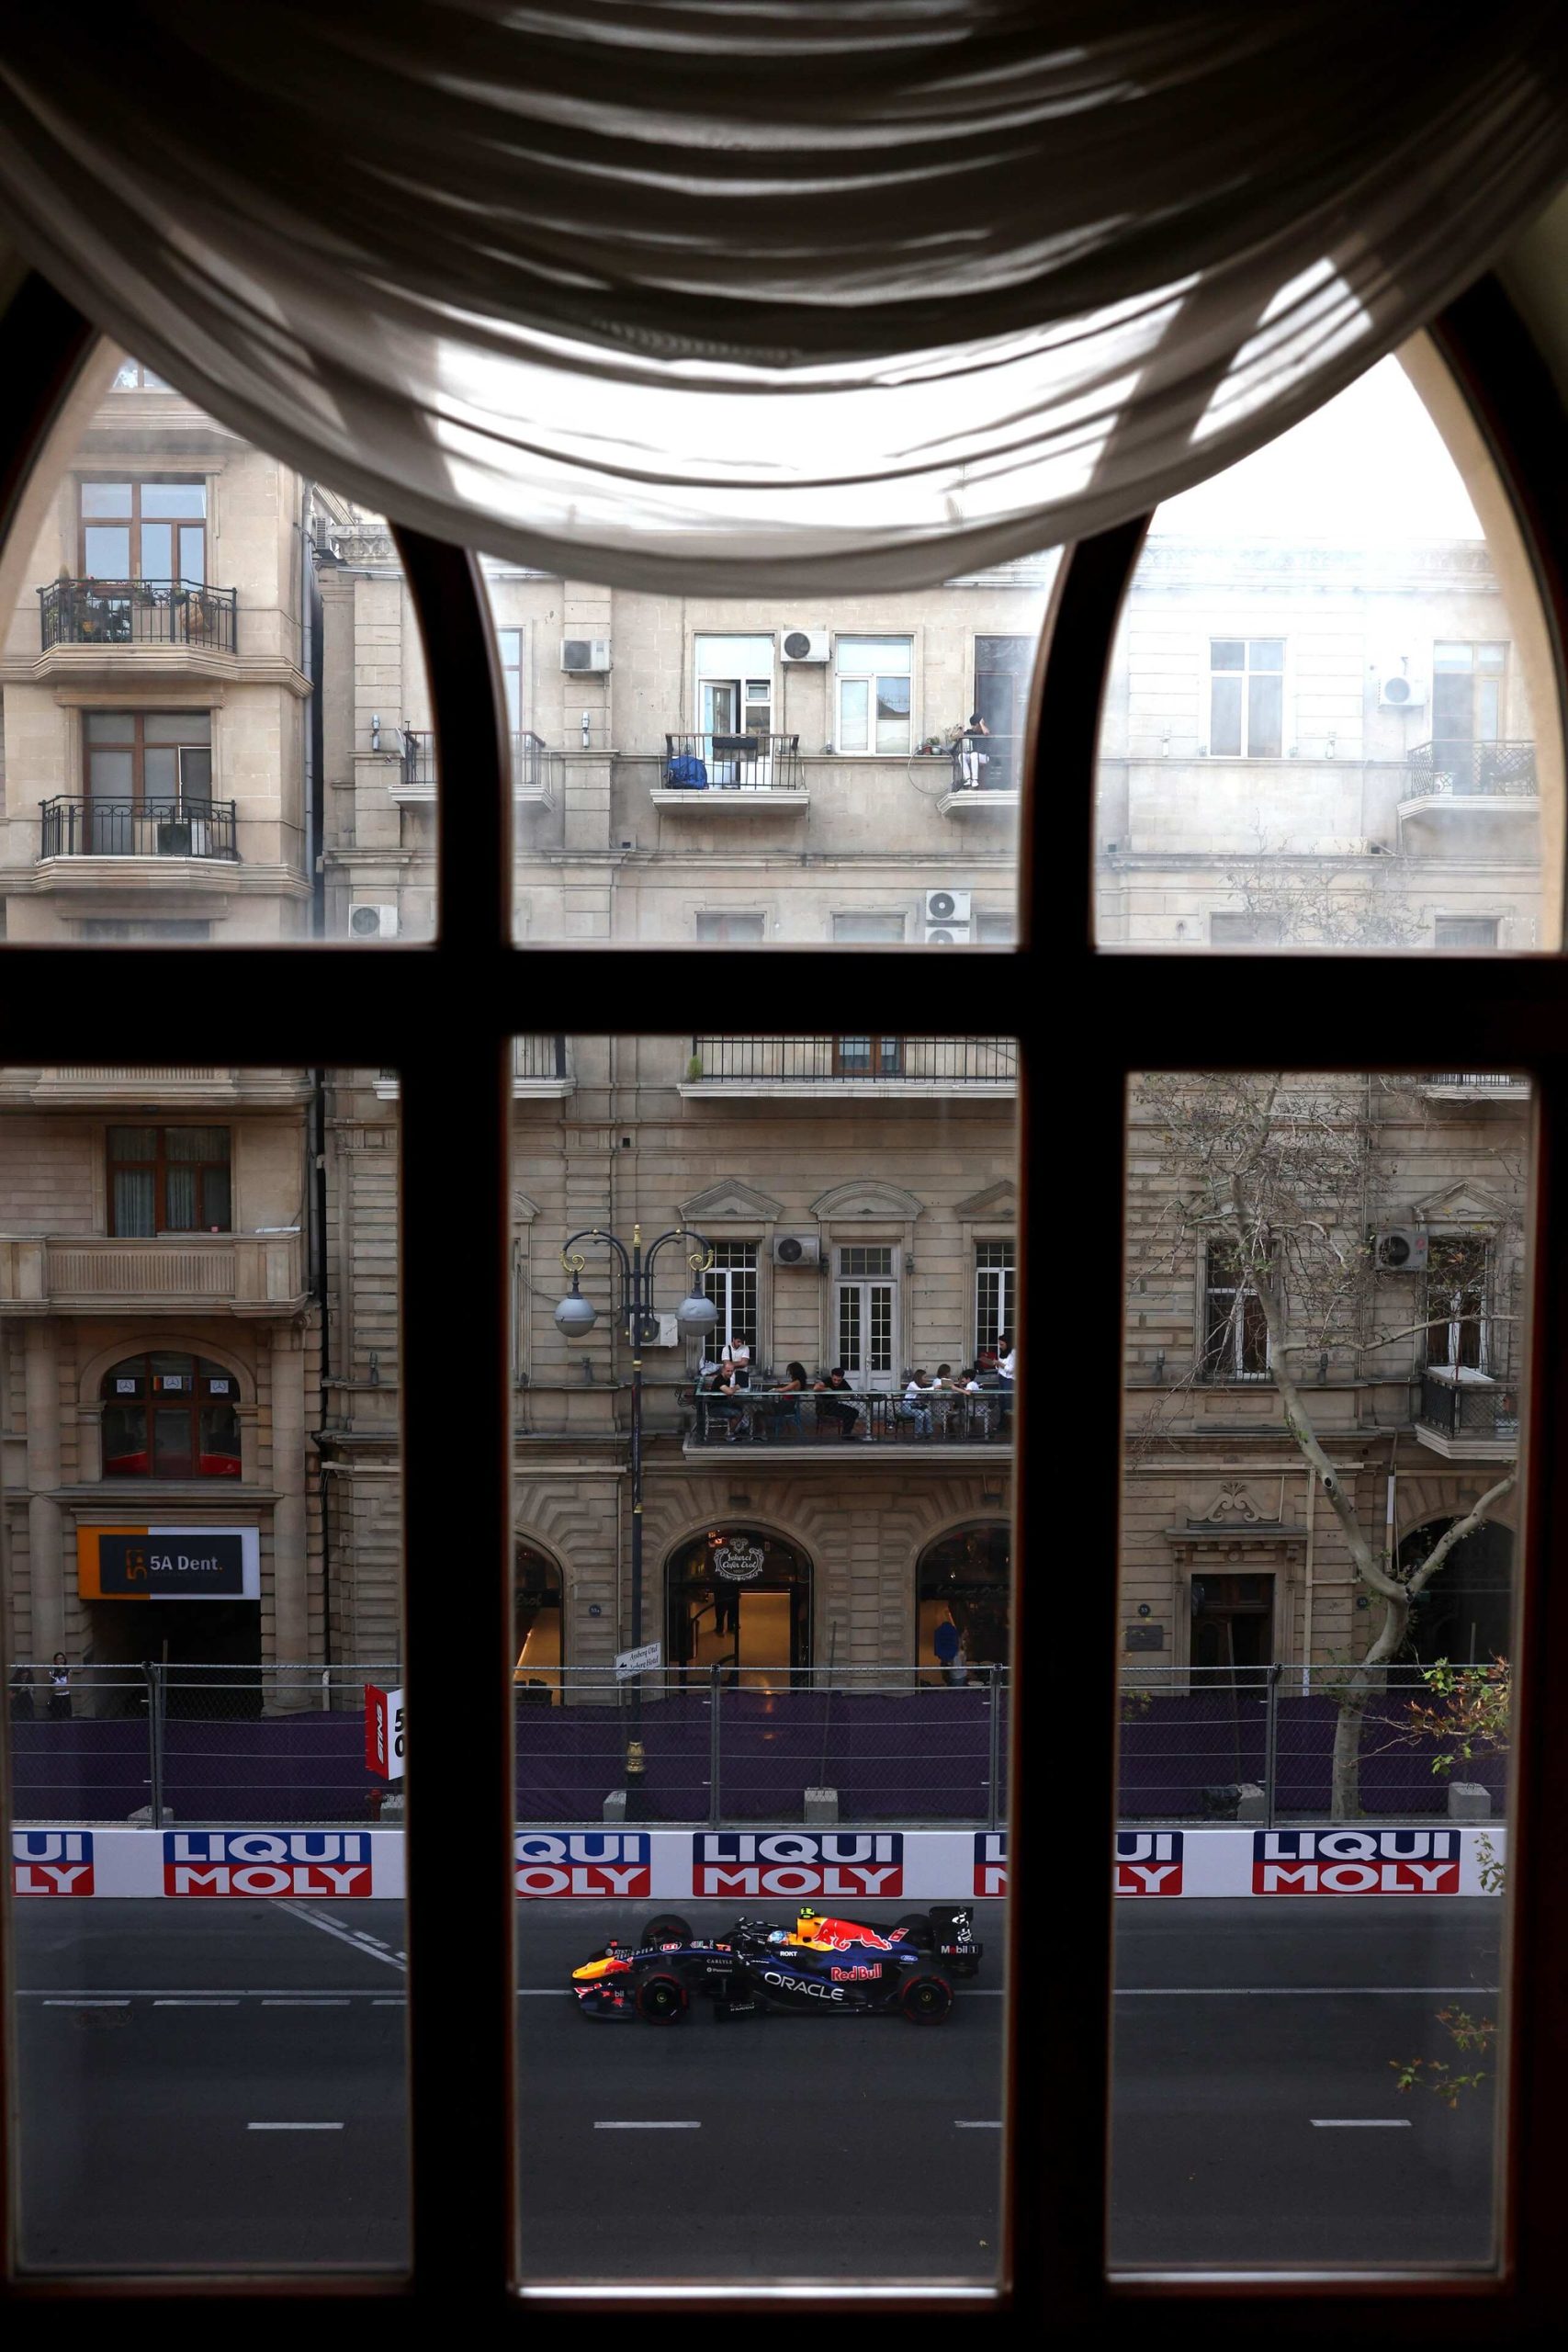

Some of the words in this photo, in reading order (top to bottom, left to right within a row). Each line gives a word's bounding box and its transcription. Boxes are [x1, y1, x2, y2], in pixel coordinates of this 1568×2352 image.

[150, 1555, 174, 1571] 5A
[177, 1555, 223, 1571] Dent.
[376, 1701, 384, 1765] STING
[175, 1834, 361, 1863] LIQUI
[513, 1834, 640, 1864] QUI
[704, 1834, 893, 1864] LIQUI
[1264, 1831, 1450, 1861] LIQUI
[15, 1866, 90, 1894] LY
[175, 1866, 368, 1894] MOLY
[513, 1866, 648, 1895] OLY
[704, 1867, 900, 1895] MOLY
[1263, 1863, 1457, 1893] MOLY
[941, 1945, 968, 1954] Mobil
[764, 1972, 845, 2001] ORACLE
[830, 1965, 858, 1982] Red
[858, 1962, 883, 1981] Bull
